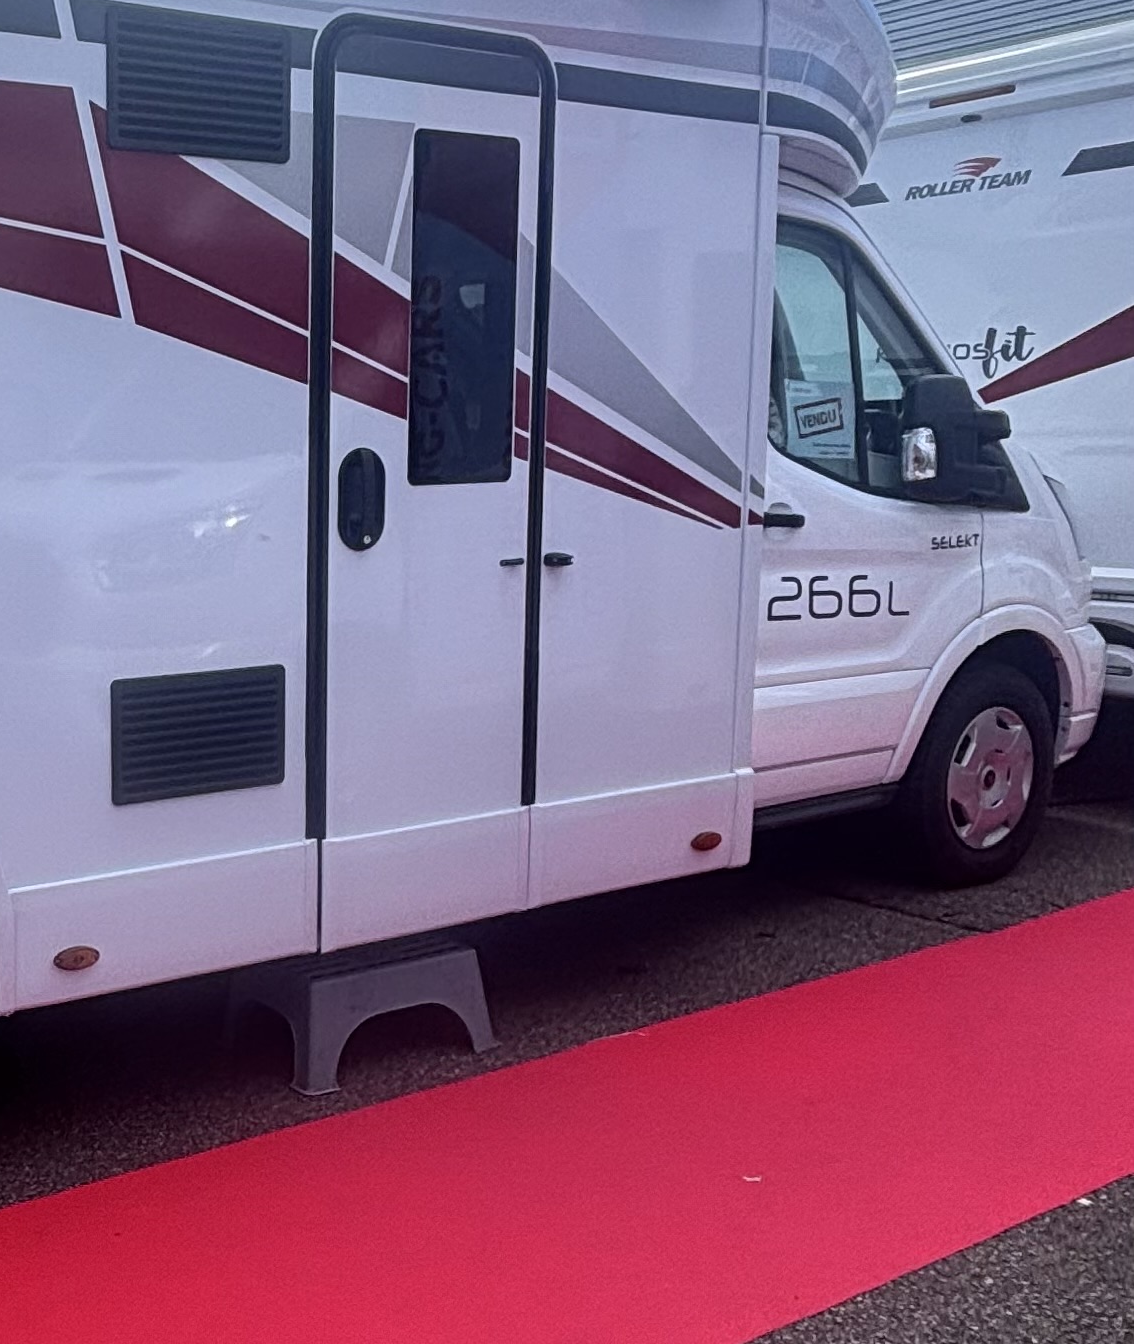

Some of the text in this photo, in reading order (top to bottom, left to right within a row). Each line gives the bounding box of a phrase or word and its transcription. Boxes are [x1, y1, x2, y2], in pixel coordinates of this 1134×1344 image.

[905, 169, 1032, 201] ROLLER TEAM
[800, 409, 837, 429] VENDU
[930, 533, 980, 551] SELEKT
[767, 574, 910, 622] 266L
